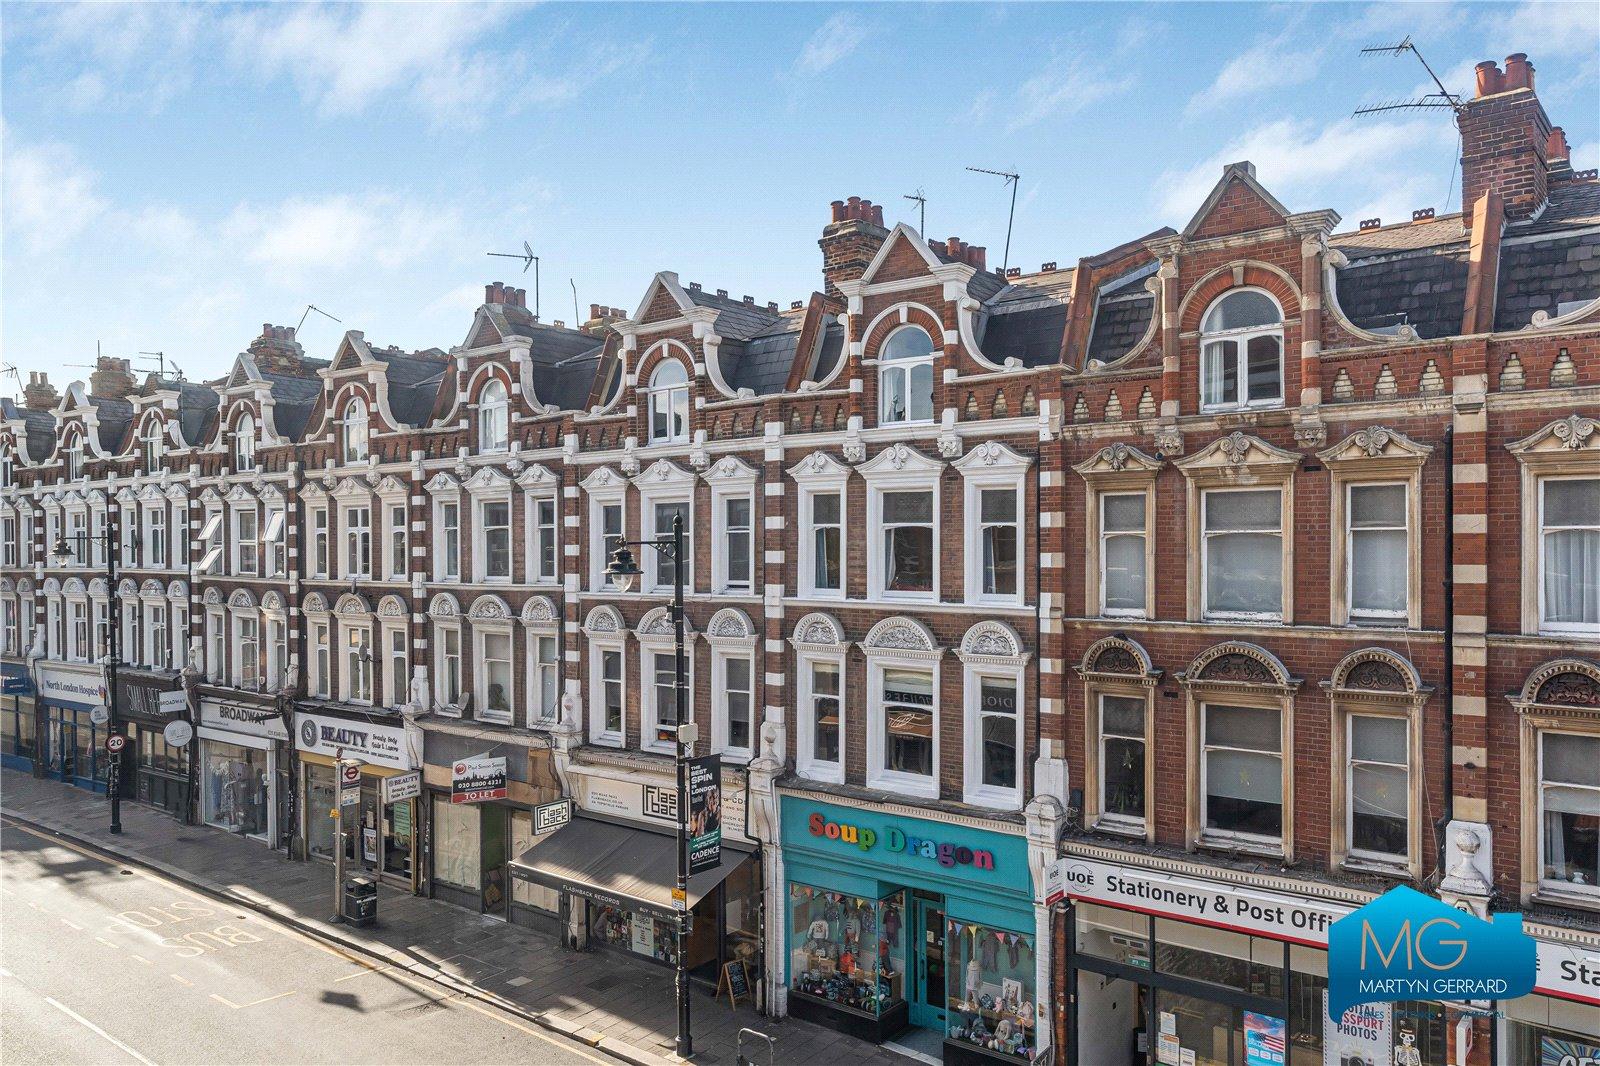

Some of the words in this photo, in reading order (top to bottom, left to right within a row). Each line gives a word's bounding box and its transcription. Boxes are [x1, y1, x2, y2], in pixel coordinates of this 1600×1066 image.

[46, 680, 61, 691] North
[61, 682, 78, 693] London
[79, 685, 98, 697] Hospice
[110, 738, 123, 748] 20
[321, 726, 369, 748] BEAUTY
[394, 776, 419, 785] BEAUTY
[691, 768, 707, 776] BEST
[691, 773, 713, 784] SPIN
[480, 790, 495, 798] LET
[691, 785, 717, 795] LONDON
[539, 805, 567, 823] Flash
[652, 795, 676, 816] bac
[543, 814, 567, 825] back
[808, 813, 877, 851] Soup
[884, 826, 995, 871] Dragon
[691, 845, 720, 860] CADENCE
[1067, 871, 1094, 886] UOE
[562, 885, 593, 898] FLASHBACK
[593, 894, 620, 906] RECORDS
[1106, 875, 1207, 914] Stationery
[1213, 895, 1230, 914] &
[1236, 897, 1284, 925] Post
[1291, 910, 1332, 932] Offi
[160, 925, 264, 957] BUS
[1560, 960, 1600, 987] Sta
[1343, 1012, 1384, 1031] SSPORT
[1336, 1023, 1378, 1041] PHOTOS
